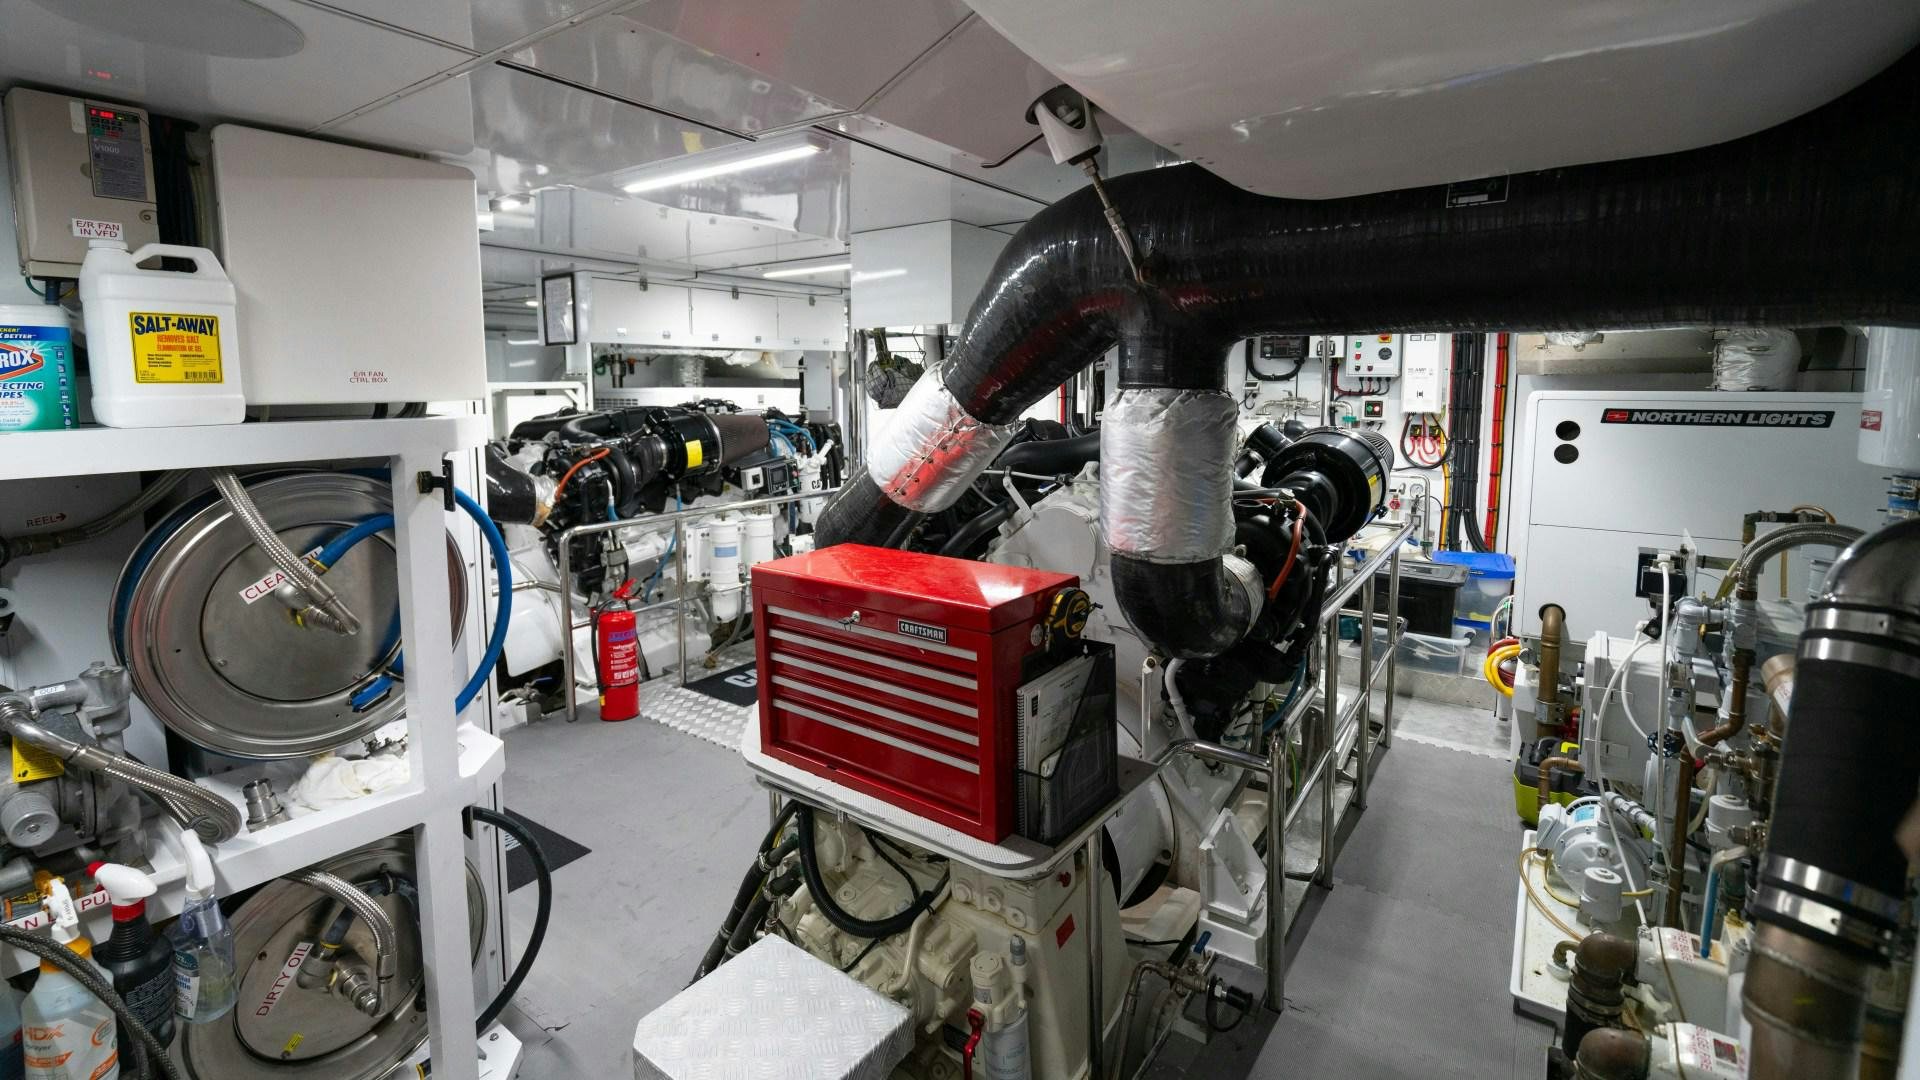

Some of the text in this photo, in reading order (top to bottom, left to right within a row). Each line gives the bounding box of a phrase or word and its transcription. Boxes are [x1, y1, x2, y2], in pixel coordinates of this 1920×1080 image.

[76, 220, 119, 231] E/R FAN
[94, 230, 118, 238] VFD
[134, 315, 214, 336] SALT-AWAY
[0, 382, 43, 390] ECTING
[1631, 411, 1827, 425] NORTHERN LIGHTS
[25, 515, 57, 529] REEL
[245, 572, 286, 600] CLEA
[900, 622, 944, 640] CRAFTSMAN
[255, 944, 311, 1017] DIRTY OIL
